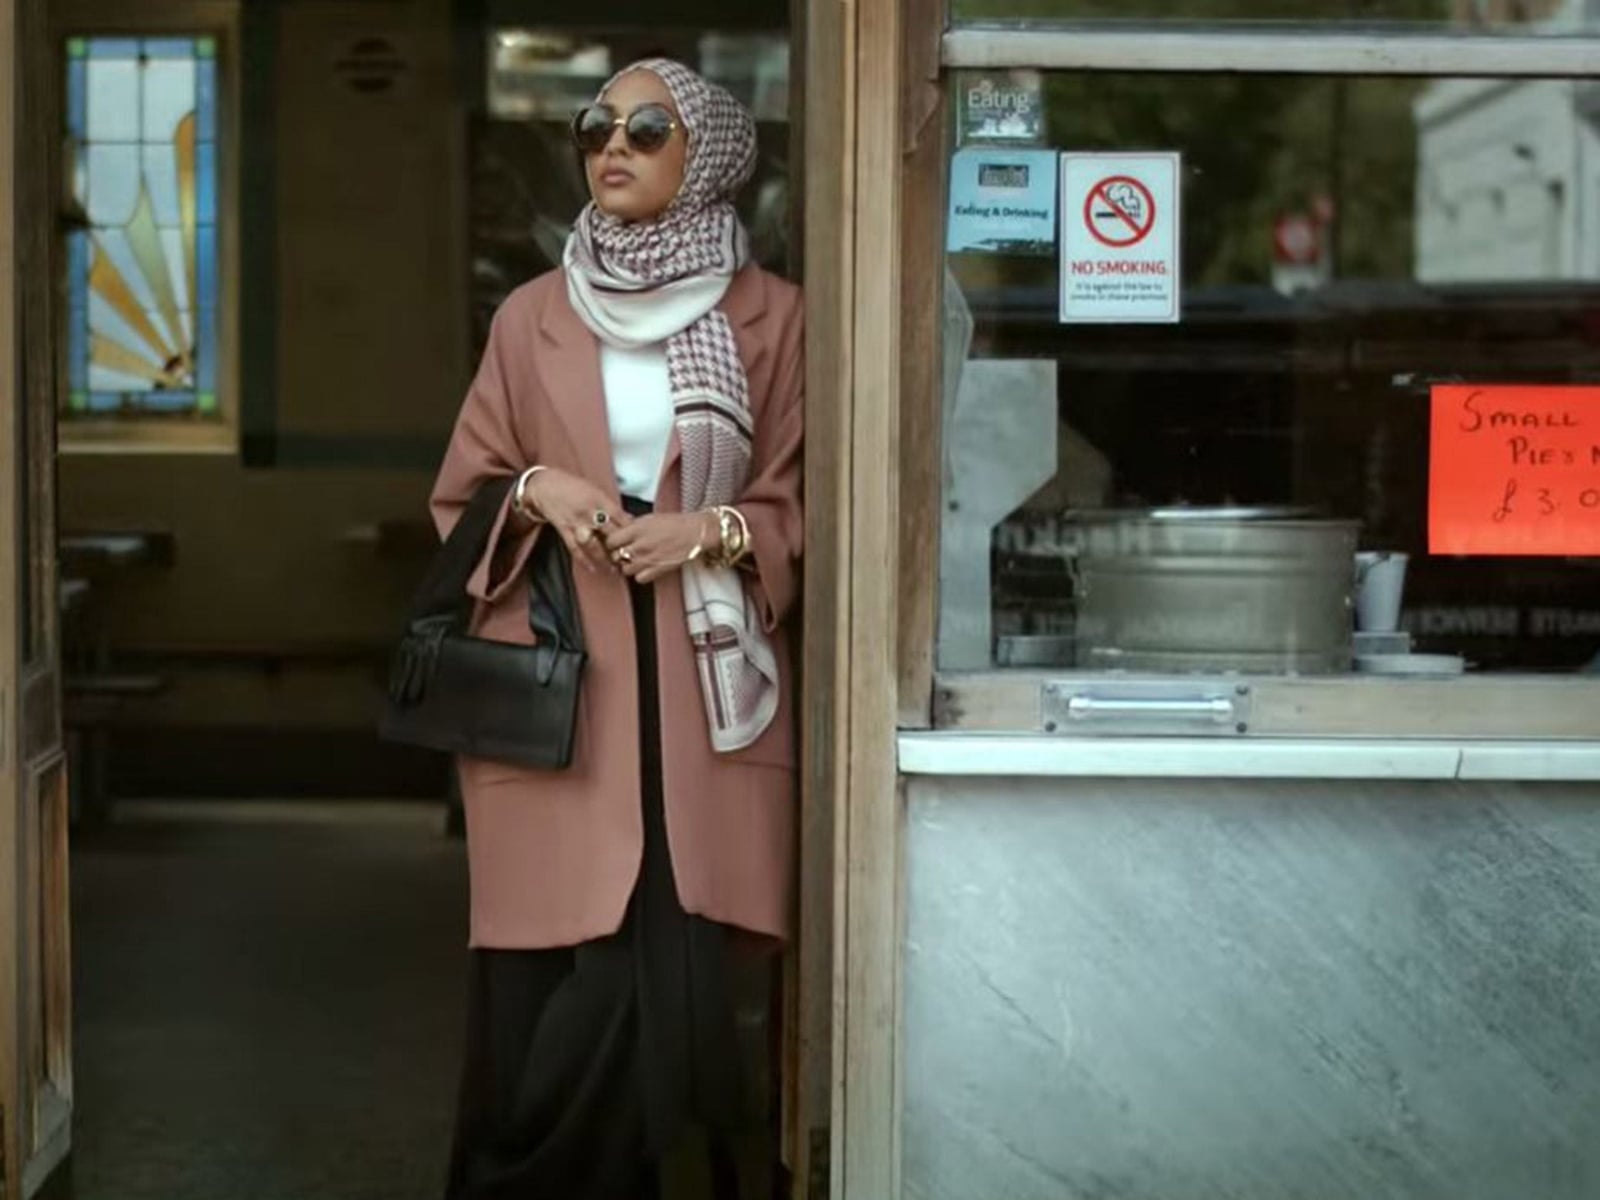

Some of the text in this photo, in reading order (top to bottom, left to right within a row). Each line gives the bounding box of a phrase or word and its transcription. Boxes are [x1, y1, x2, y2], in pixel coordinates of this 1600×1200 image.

[968, 87, 1030, 113] Eating
[1002, 207, 1048, 219] Drinking
[1072, 261, 1093, 274] NO
